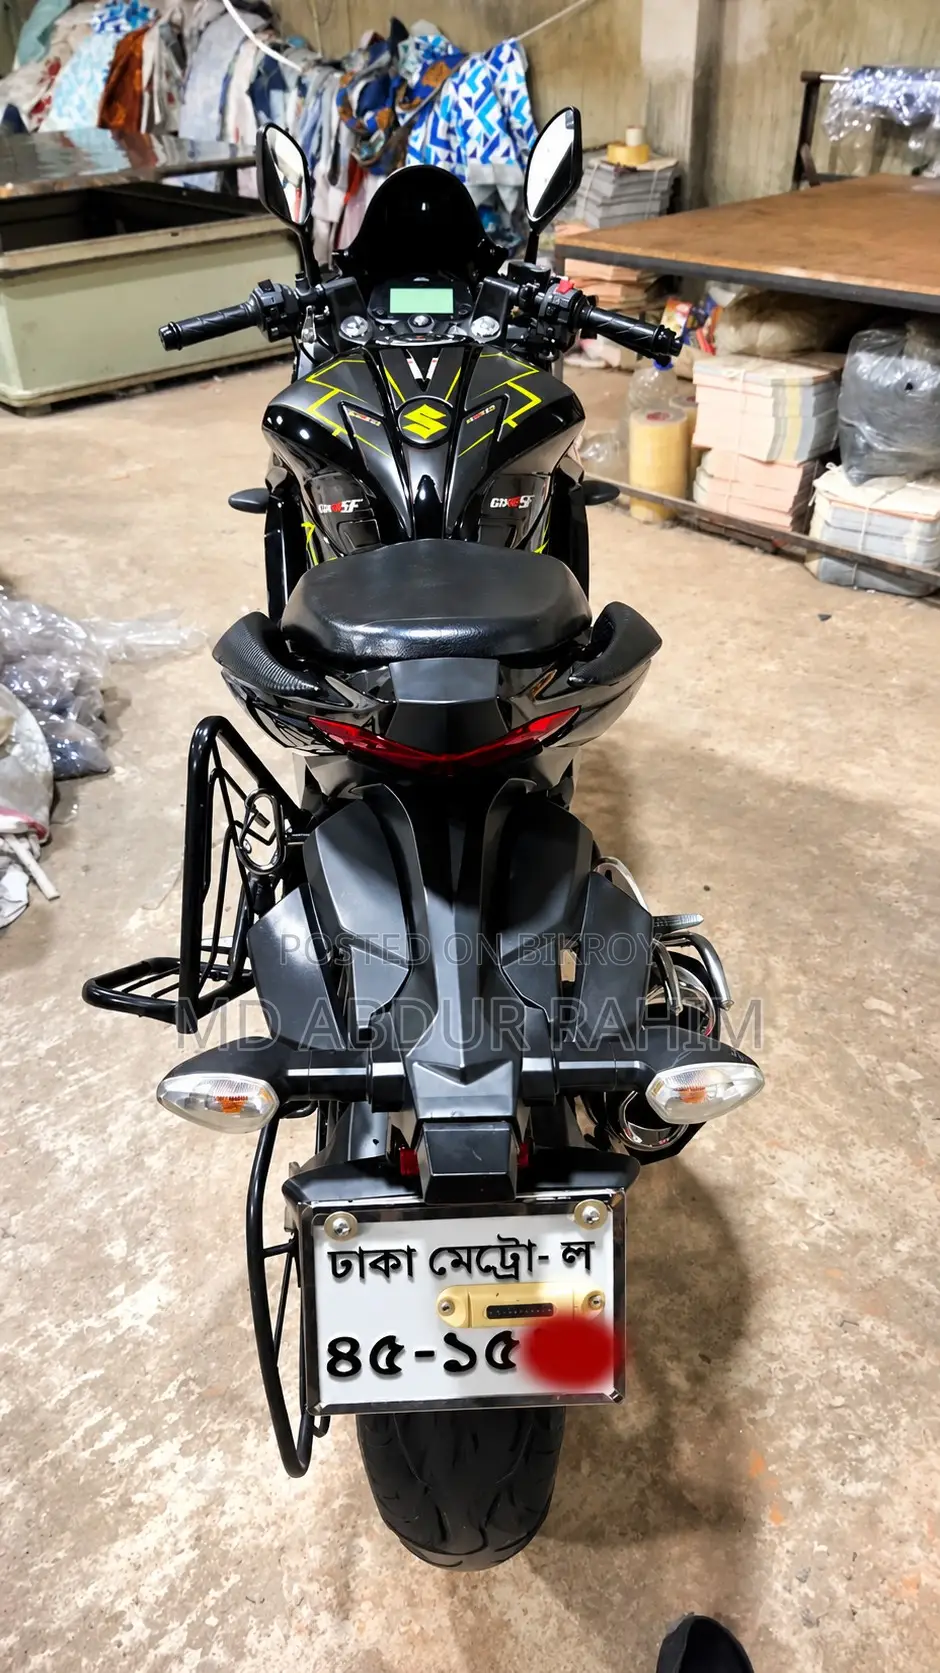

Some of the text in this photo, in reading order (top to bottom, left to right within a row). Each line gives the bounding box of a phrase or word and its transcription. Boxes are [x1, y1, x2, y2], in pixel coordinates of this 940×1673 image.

[328, 1245, 417, 1280] ঢাকা
[560, 1240, 595, 1274] ল
[327, 1330, 521, 1377] ৪৫-১৫
